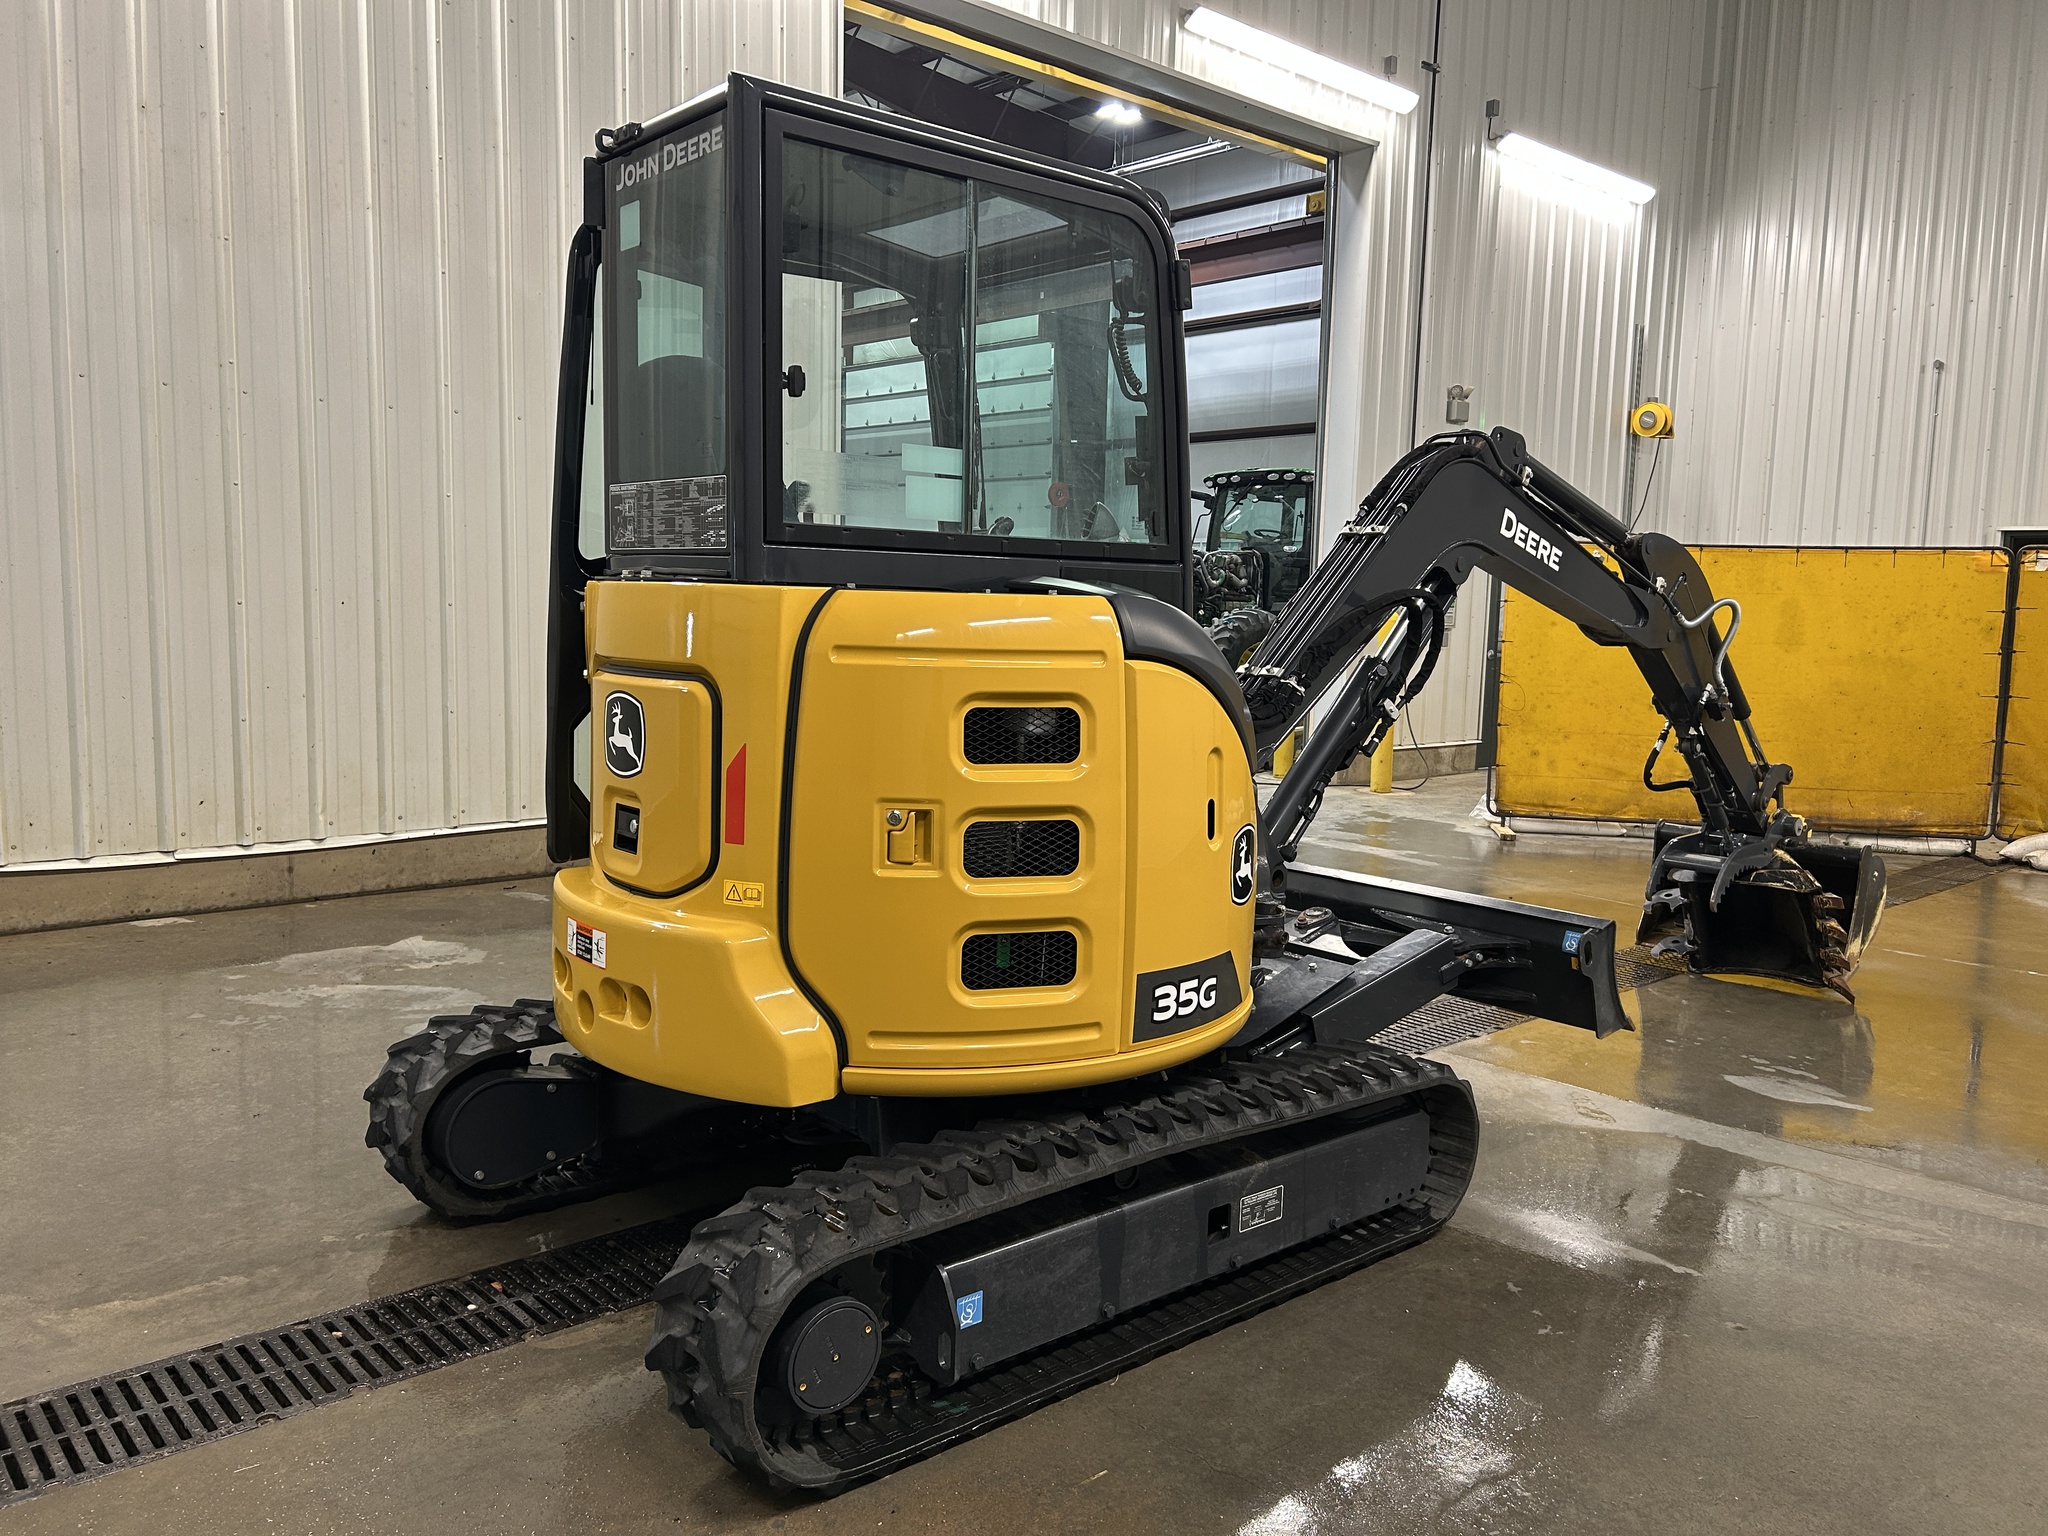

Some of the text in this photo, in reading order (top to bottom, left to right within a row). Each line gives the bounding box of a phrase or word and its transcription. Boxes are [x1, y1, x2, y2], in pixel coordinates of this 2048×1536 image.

[616, 125, 723, 191] JOHN DEERE
[1500, 507, 1563, 572] DEERE
[1153, 977, 1217, 1021] 35G
